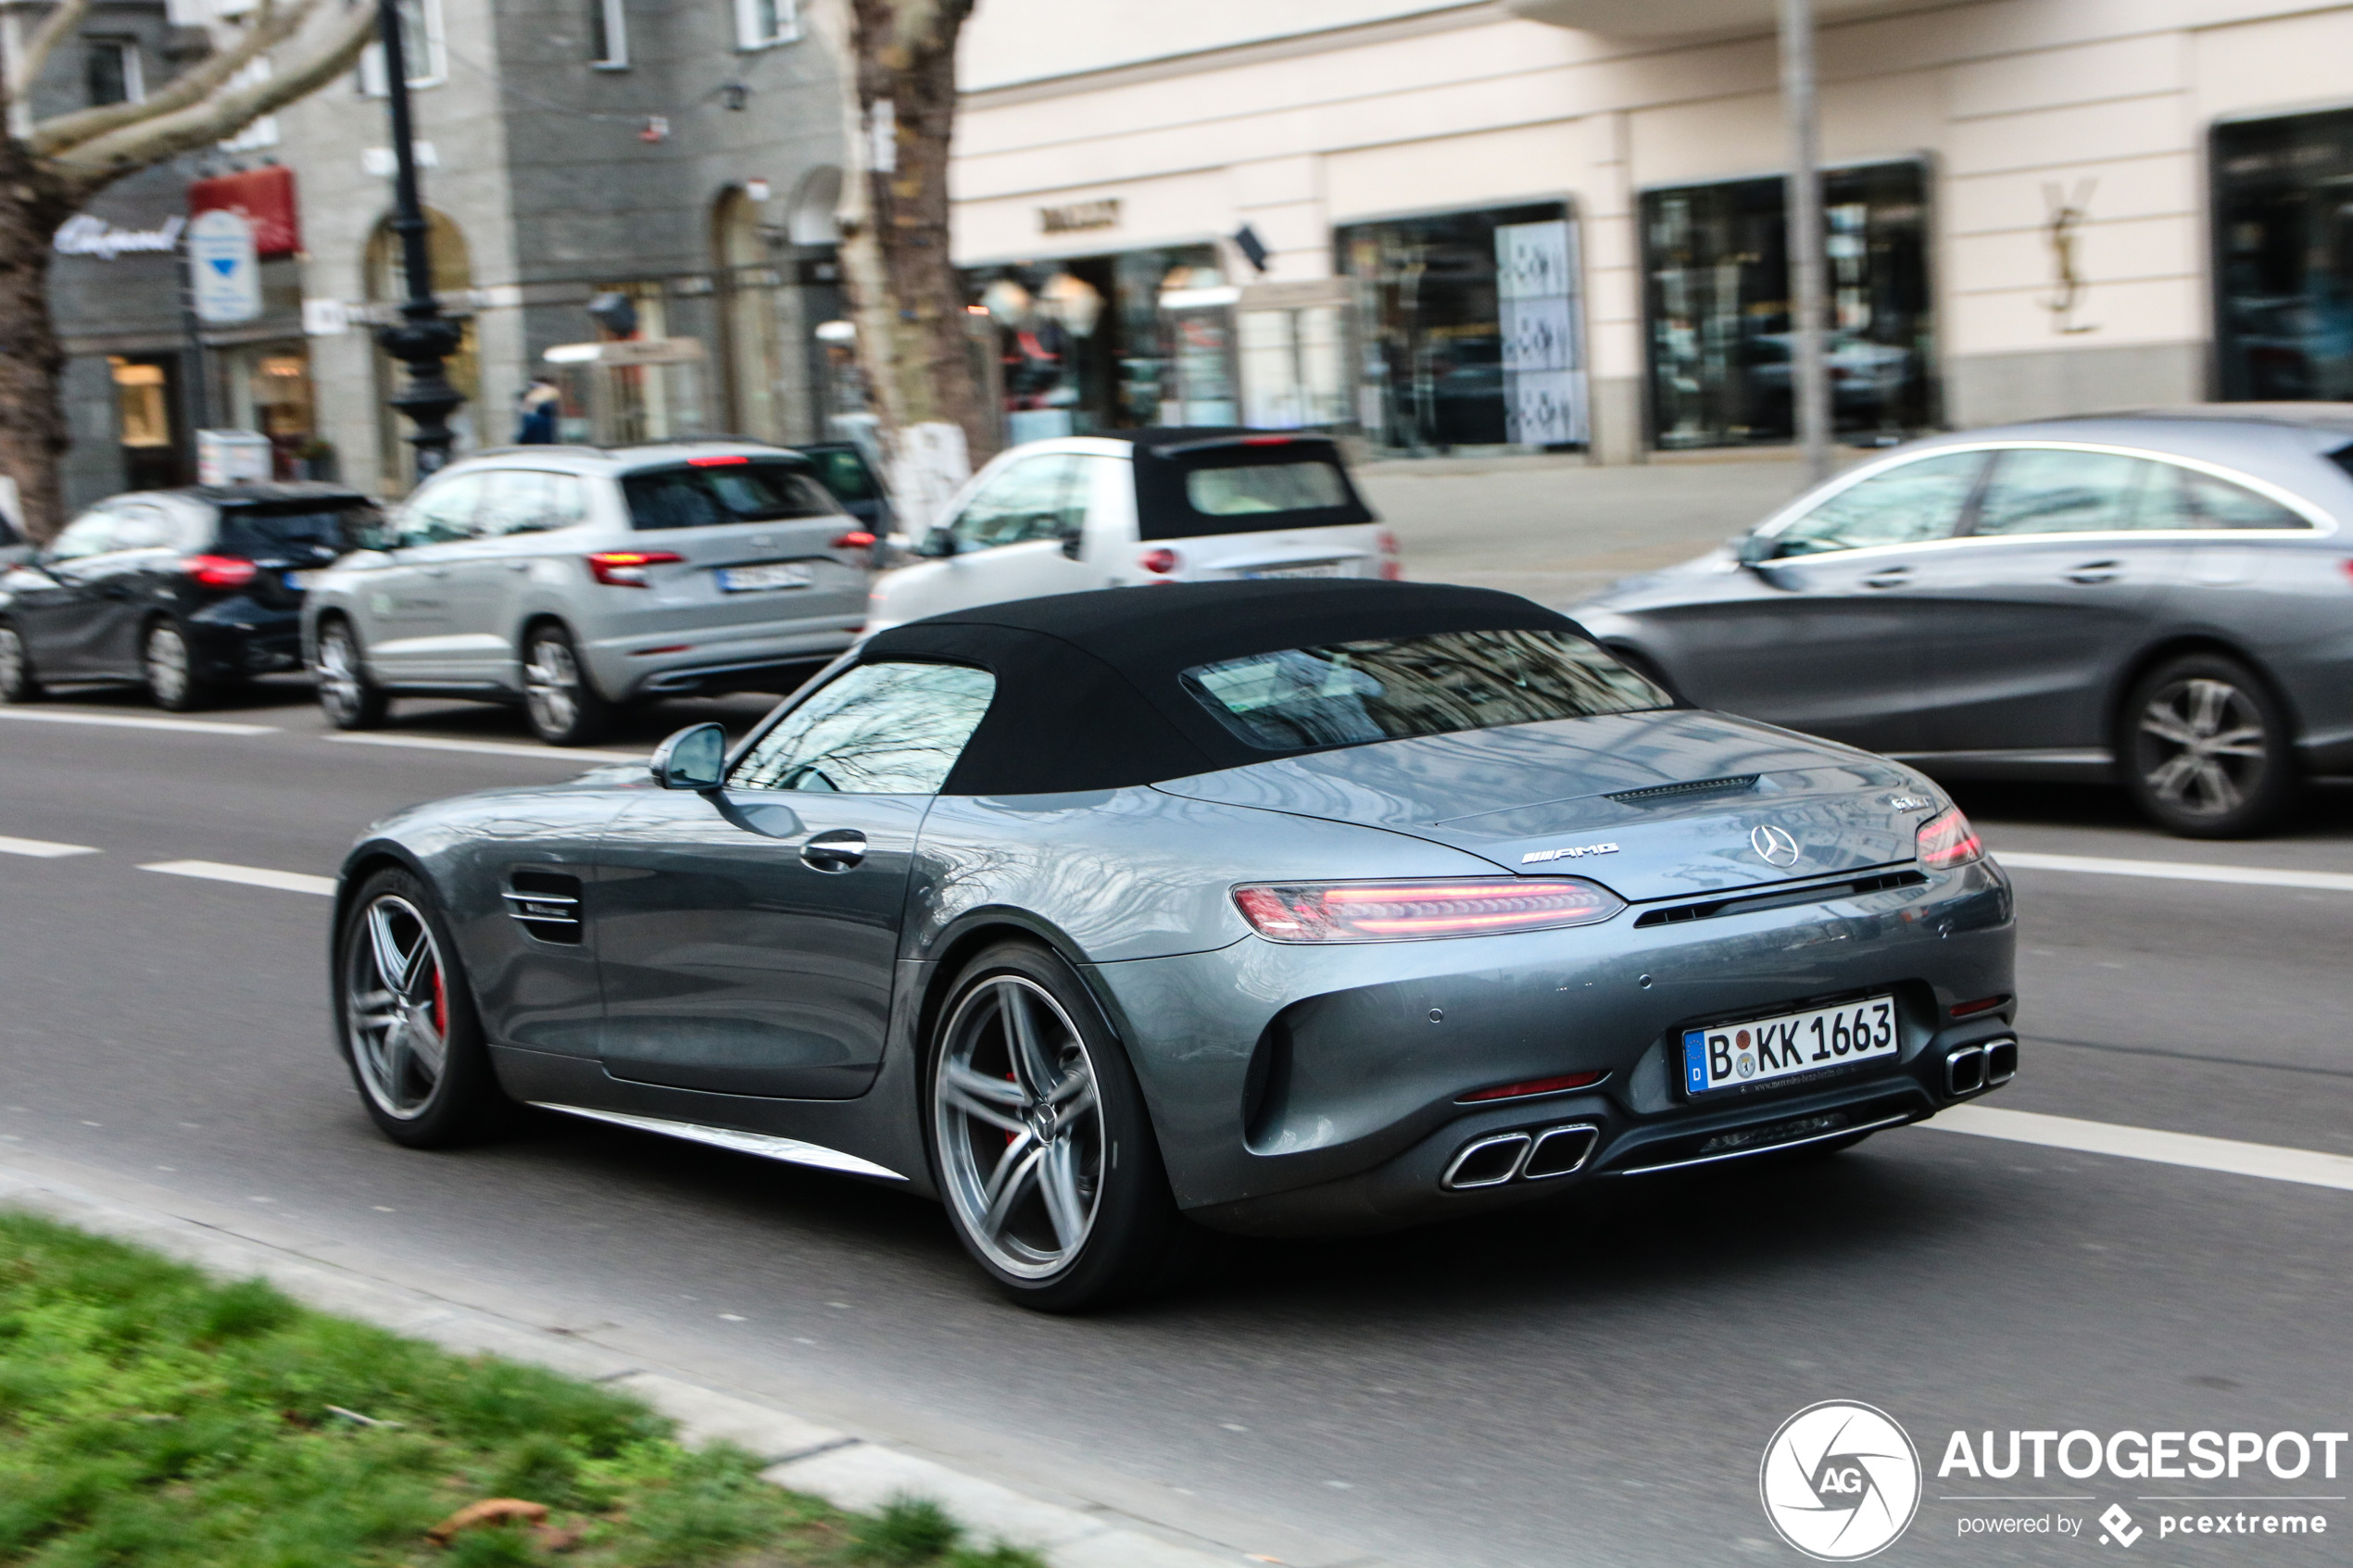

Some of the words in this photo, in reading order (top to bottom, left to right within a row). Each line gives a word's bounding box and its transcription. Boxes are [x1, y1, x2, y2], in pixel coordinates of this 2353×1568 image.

[1554, 843, 1619, 860] AMG
[1708, 1035, 1732, 1081] B
[1756, 1021, 1803, 1072] KK
[1811, 1003, 1891, 1061] 1663
[1692, 1067, 1701, 1082] D
